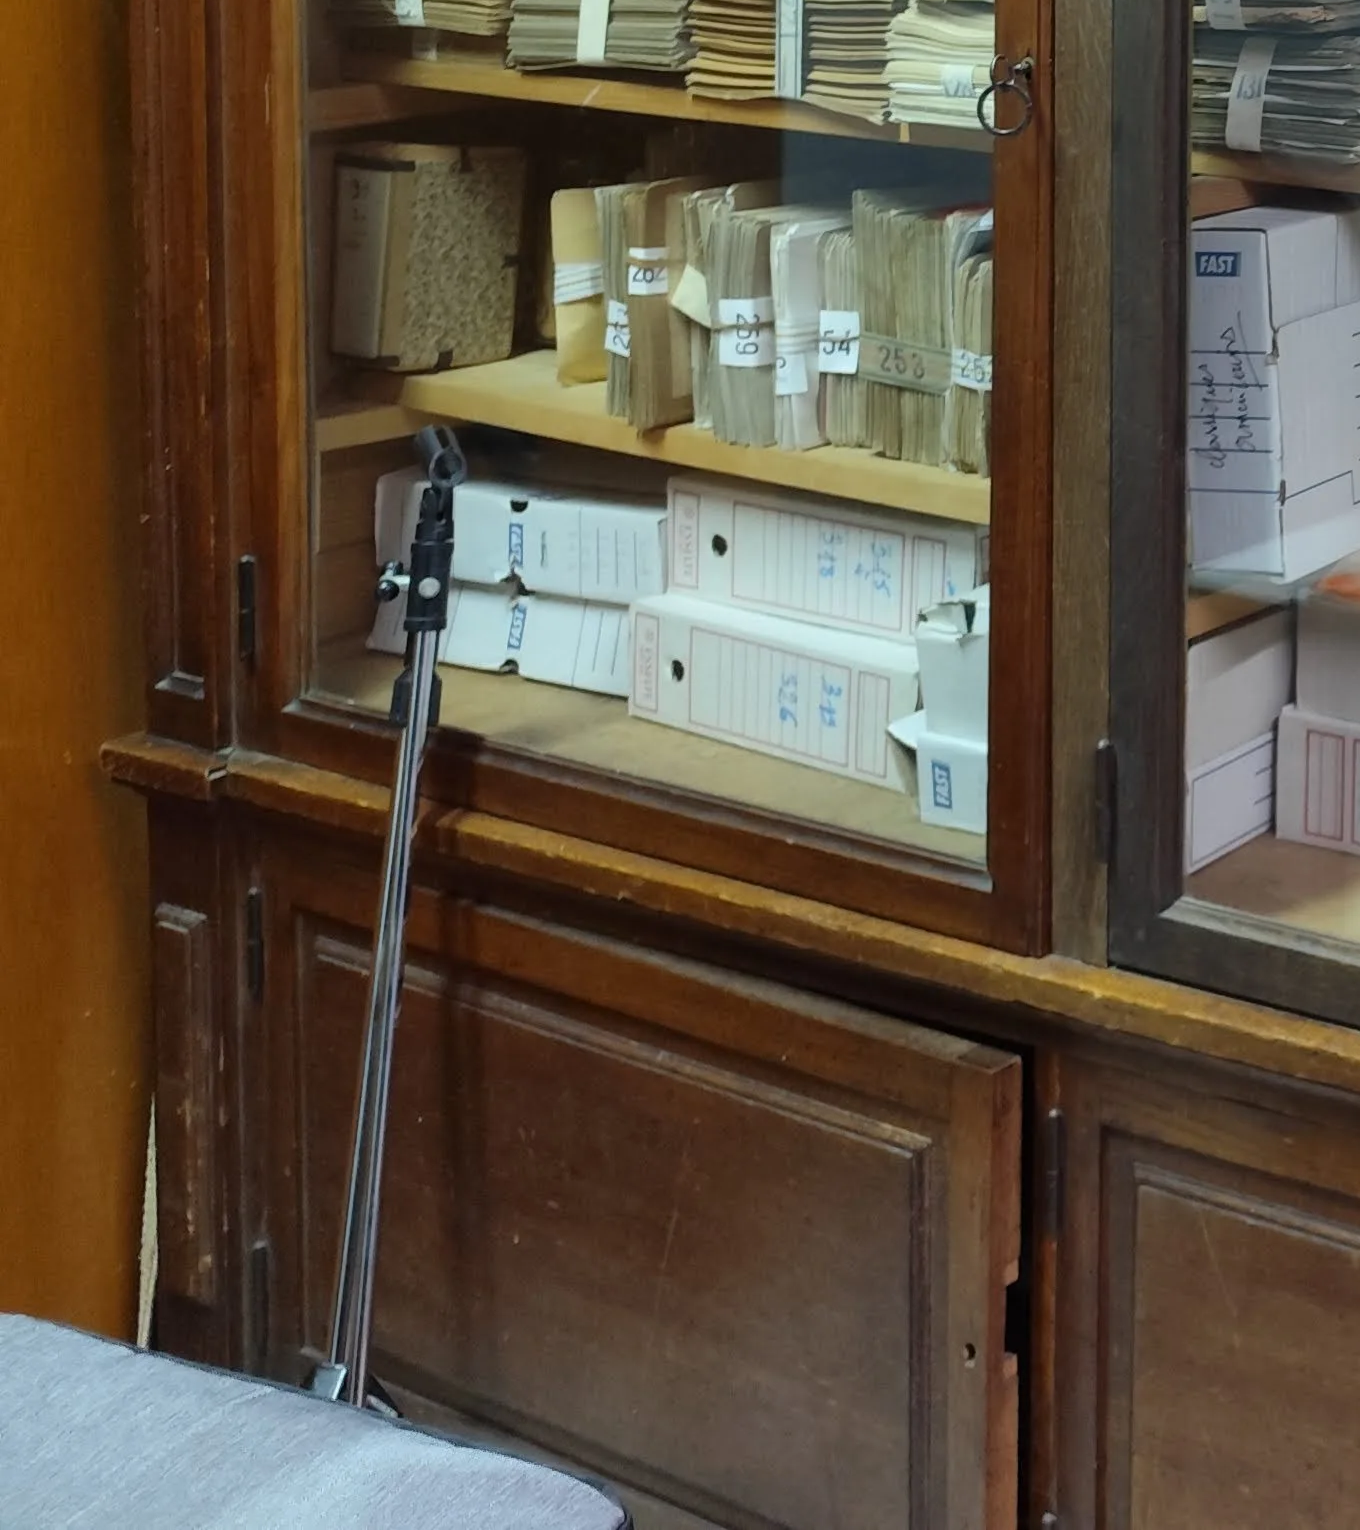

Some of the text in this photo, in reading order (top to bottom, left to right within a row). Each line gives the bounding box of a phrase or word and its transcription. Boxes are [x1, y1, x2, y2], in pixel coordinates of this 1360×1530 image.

[1199, 253, 1236, 275] FAST
[735, 312, 761, 356] 259
[933, 763, 952, 806] FAST
